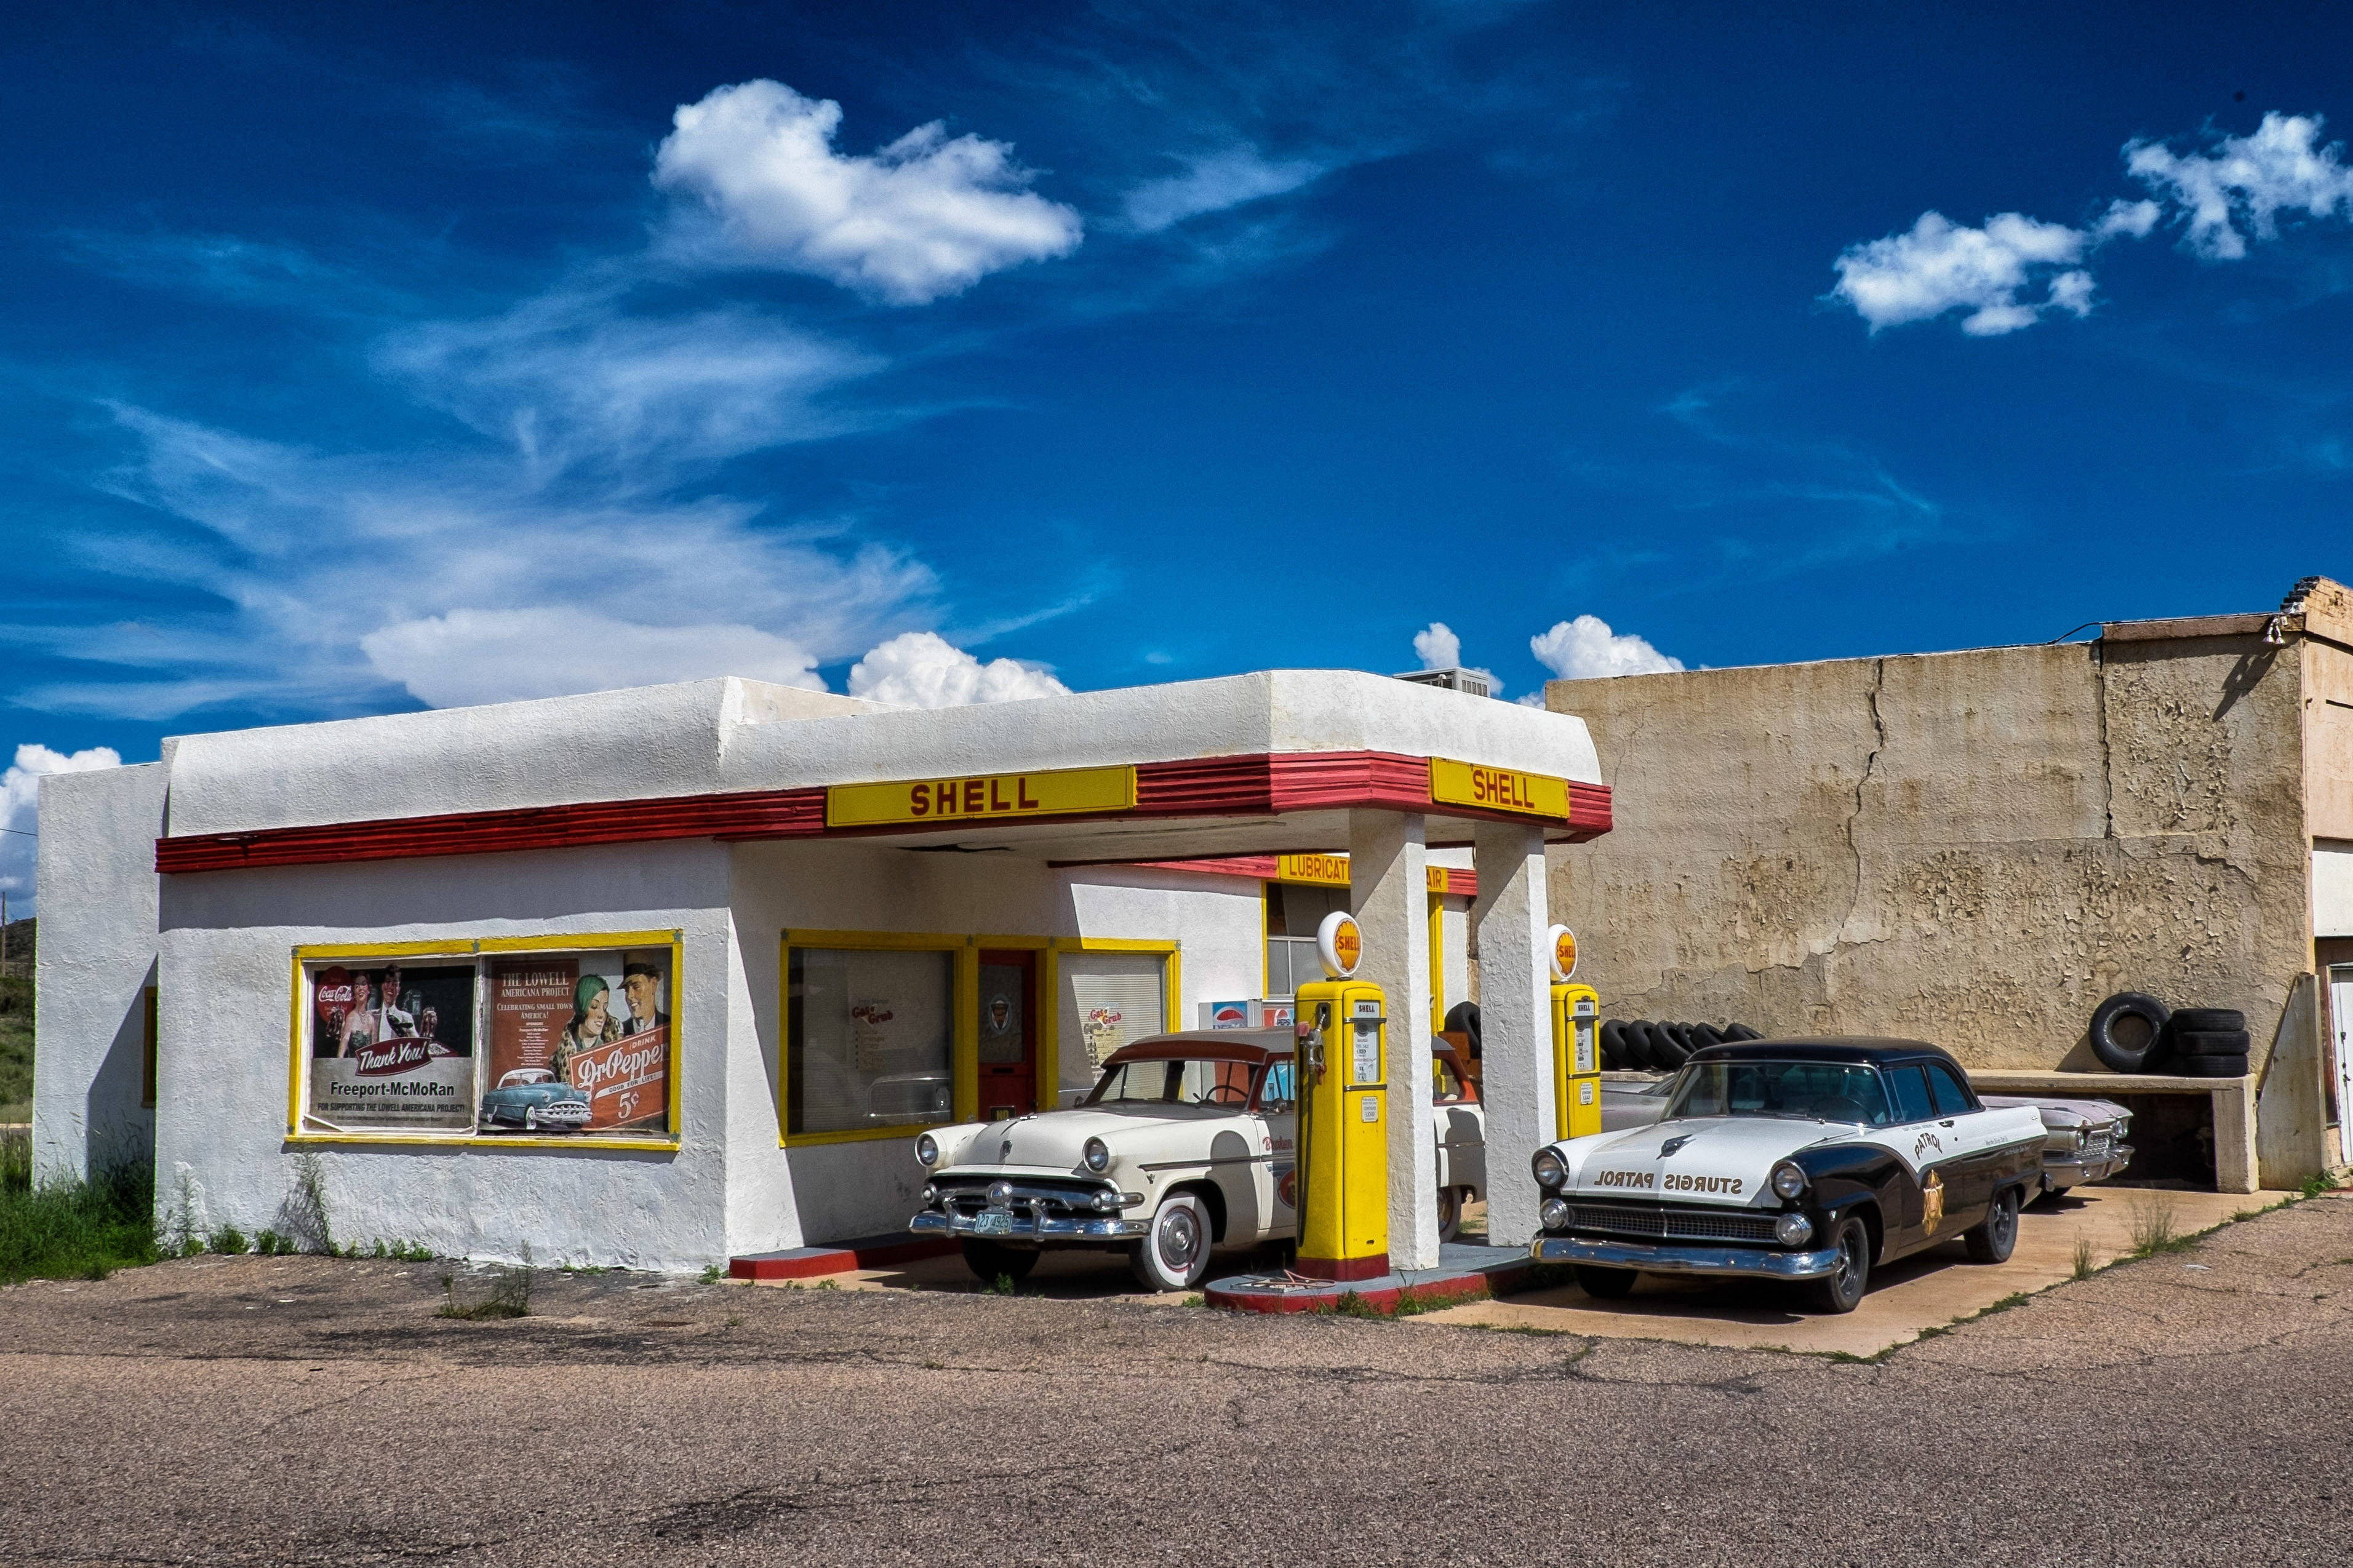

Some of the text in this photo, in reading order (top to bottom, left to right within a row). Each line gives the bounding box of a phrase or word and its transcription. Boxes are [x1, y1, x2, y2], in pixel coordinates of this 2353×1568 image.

[1472, 769, 1535, 808] SHELL
[910, 777, 1039, 816] SHELL
[1338, 936, 1359, 951] SHELL
[501, 972, 569, 987] THE LOWELL
[501, 987, 570, 997] AMERICANA PROJECT
[1102, 1012, 1122, 1025] Grub
[631, 1035, 656, 1049] DRINK
[360, 1041, 427, 1072] Thank You!
[330, 1081, 455, 1099] Freeport-McMoRan
[609, 1084, 625, 1093] GOOD
[626, 1079, 639, 1088] FOR
[317, 1102, 465, 1113] FOR SUPPORTING THE LOWELL AMERICANA PROJECT!
[618, 1091, 639, 1119] 5¢
[1914, 1132, 1943, 1160] PATROL
